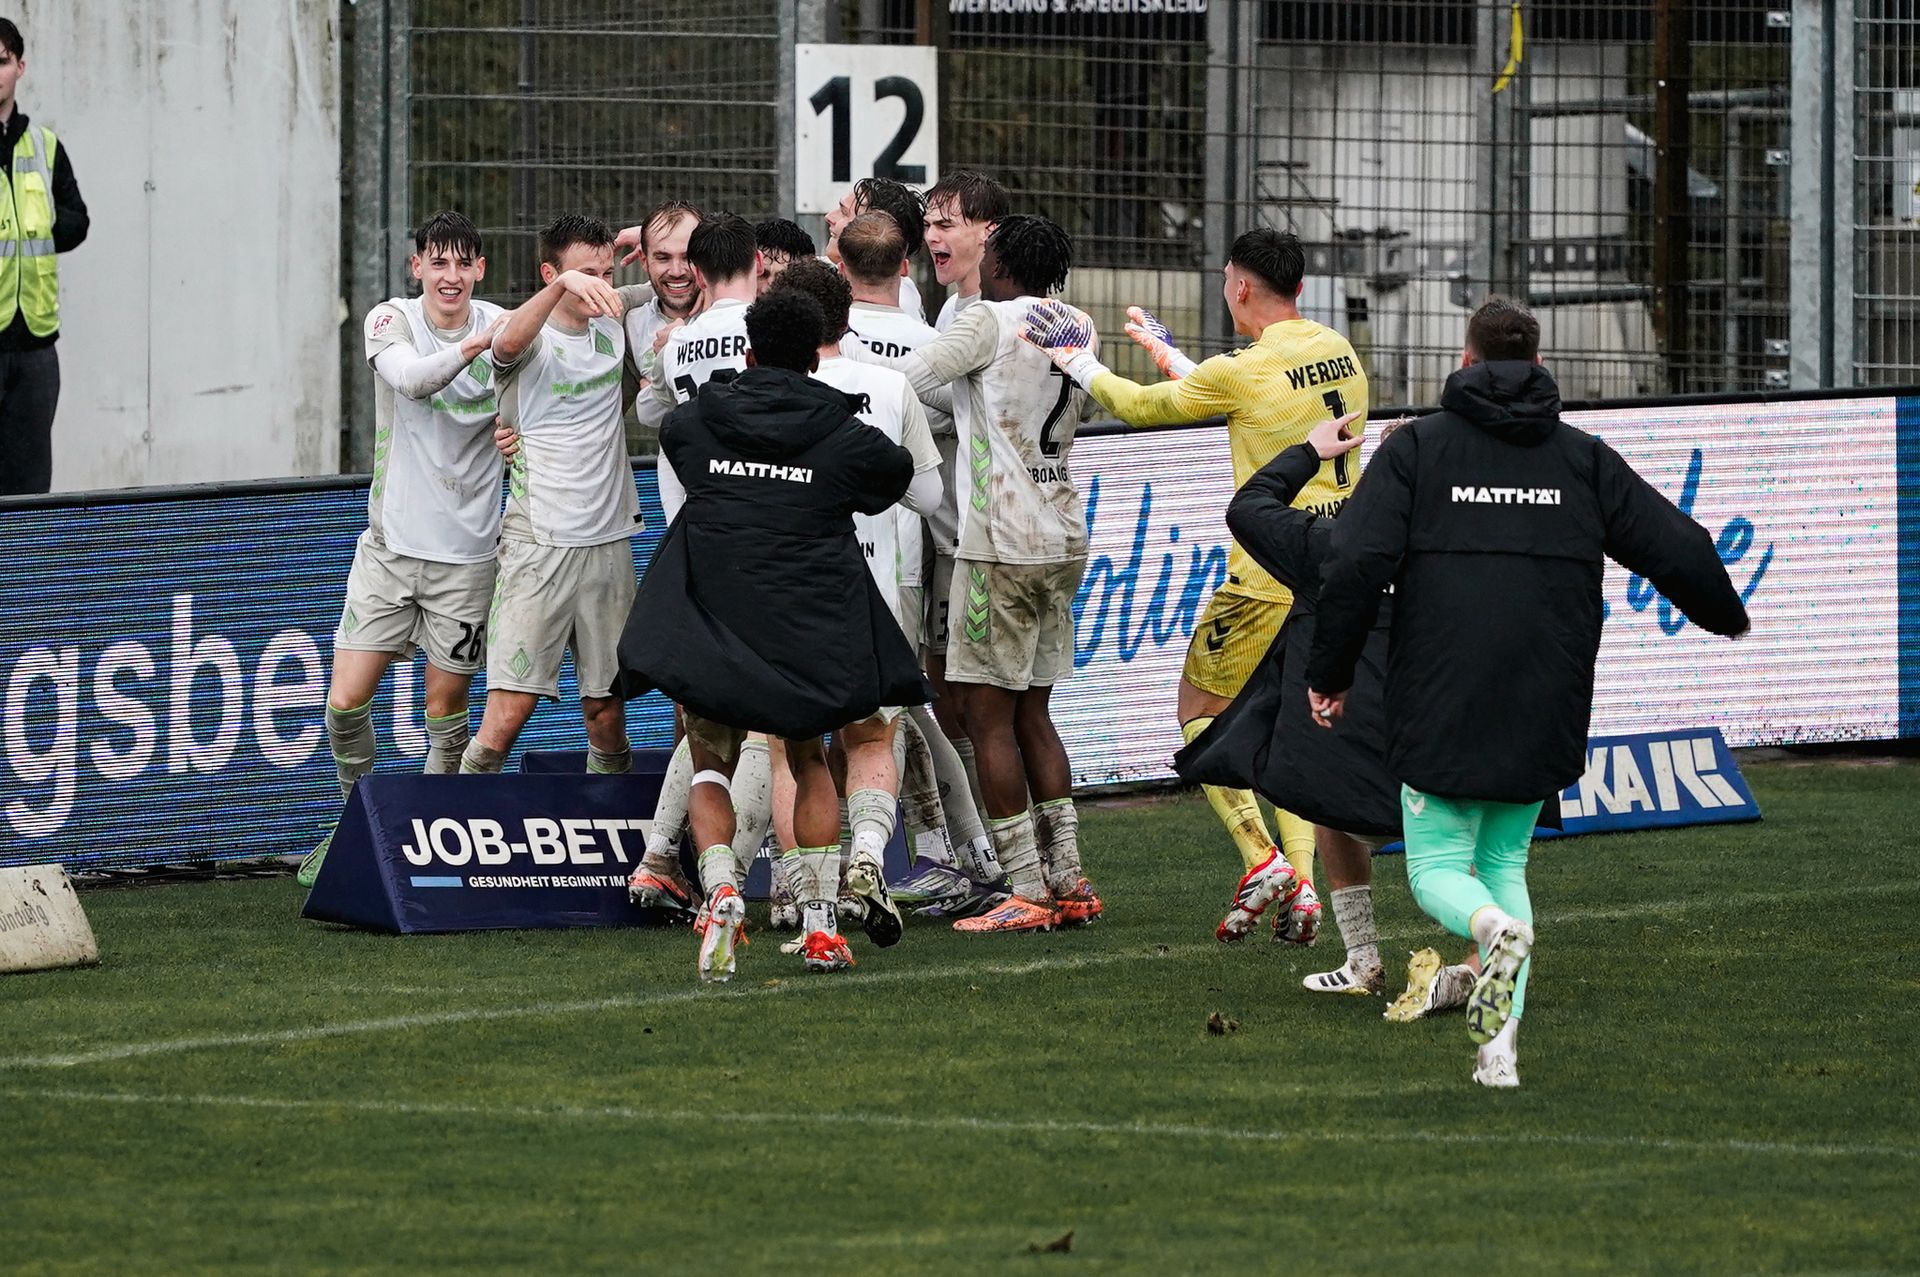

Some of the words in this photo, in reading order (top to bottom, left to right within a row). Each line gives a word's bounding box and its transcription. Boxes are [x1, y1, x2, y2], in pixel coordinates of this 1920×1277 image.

[809, 75, 926, 184] 12
[677, 335, 746, 366] WERDER
[1285, 355, 1357, 390] WERDER
[1322, 389, 1351, 489] 1
[709, 459, 813, 484] MATTHÄI
[1451, 486, 1561, 505] MATTHÄI
[449, 621, 485, 663] 26
[468, 876, 550, 888] GESUNDHEIT
[551, 875, 608, 888] BEGINNT
[609, 875, 626, 887] IM
